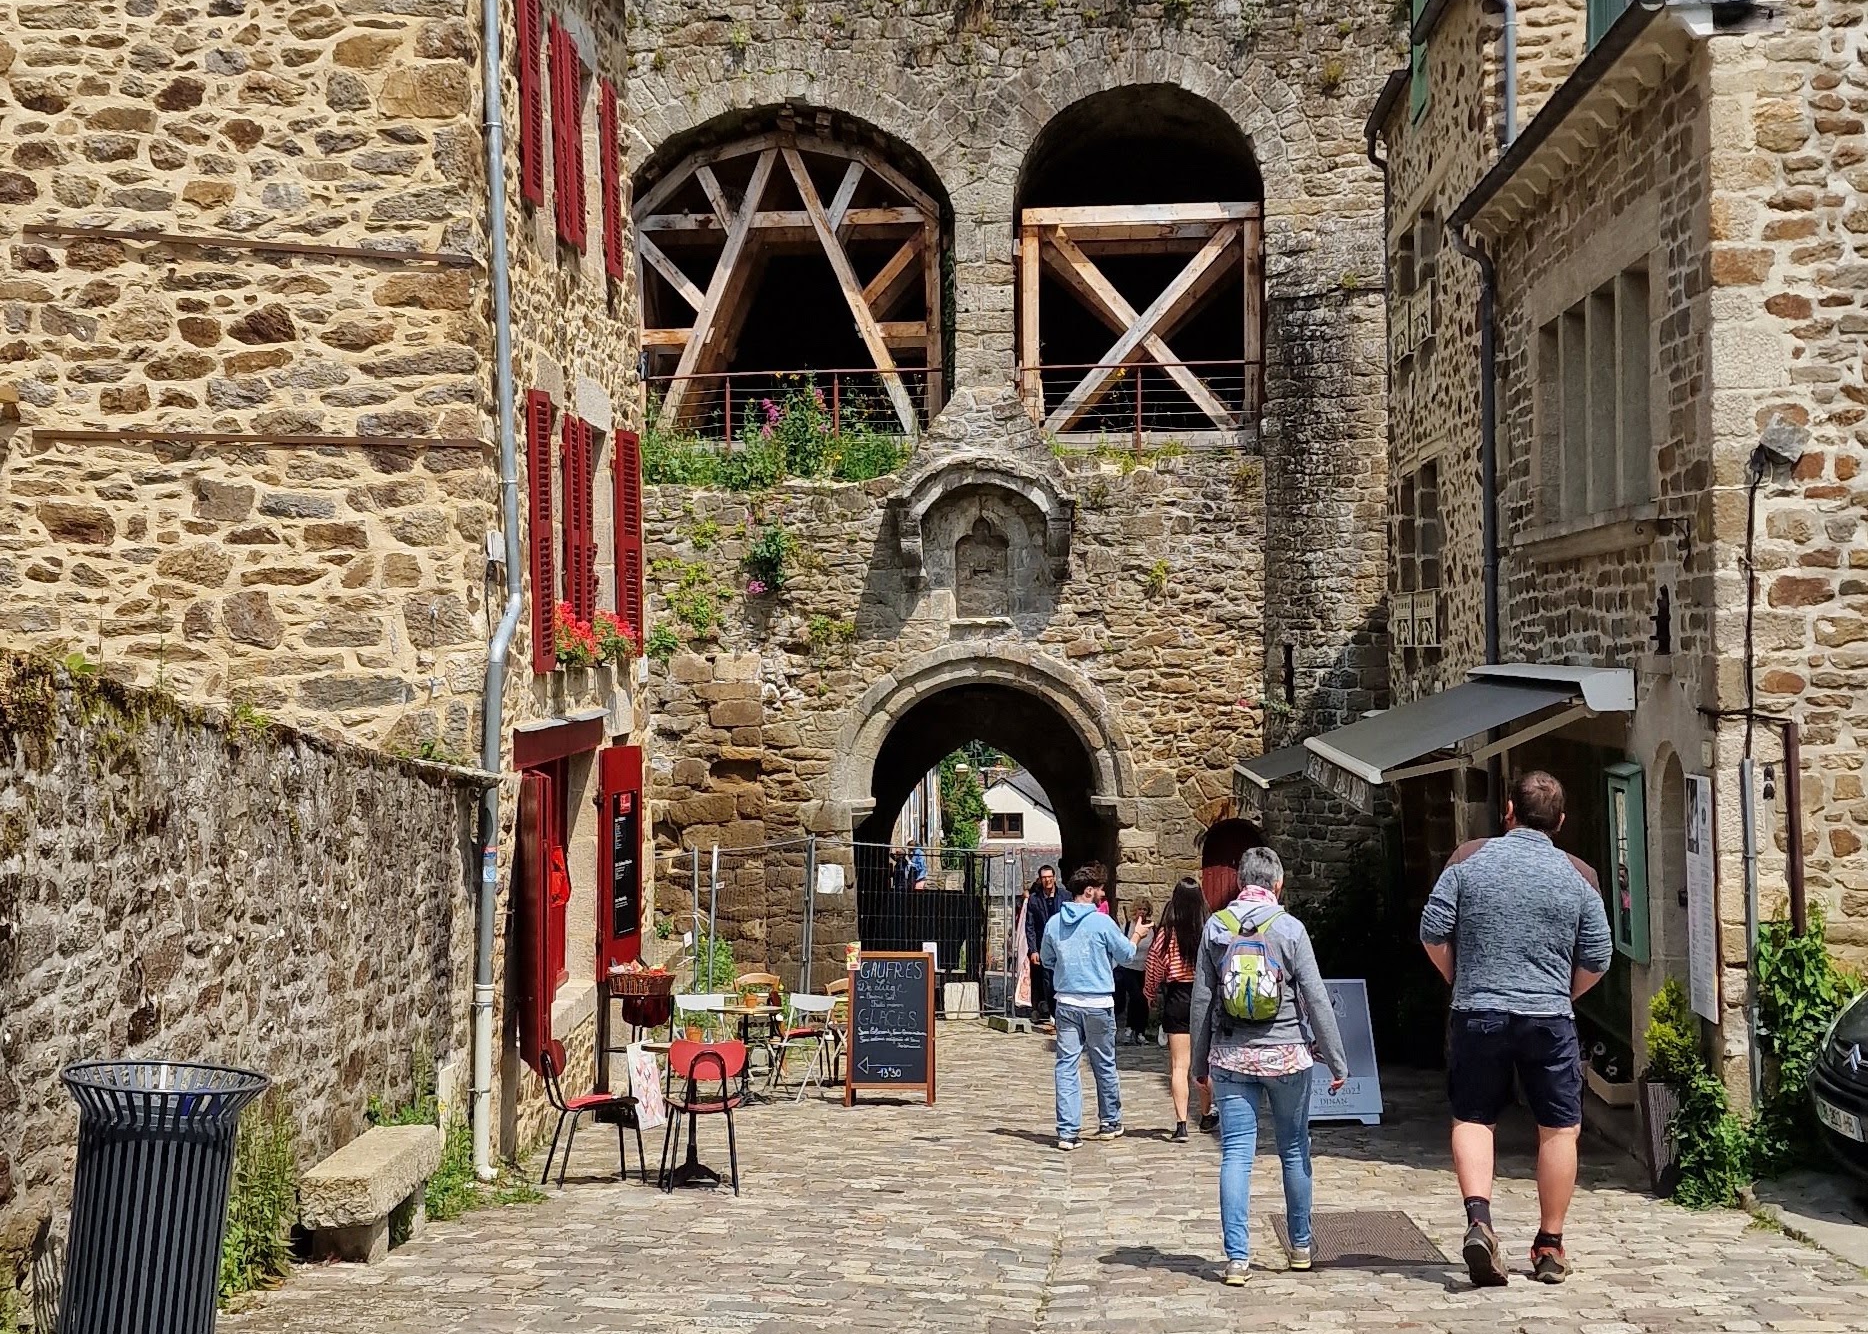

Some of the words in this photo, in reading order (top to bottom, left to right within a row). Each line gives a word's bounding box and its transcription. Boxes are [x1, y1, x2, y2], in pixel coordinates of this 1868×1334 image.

[860, 961, 923, 979] GAUFRES
[857, 1008, 917, 1028] GLACES
[1319, 1097, 1348, 1105] DINAN
